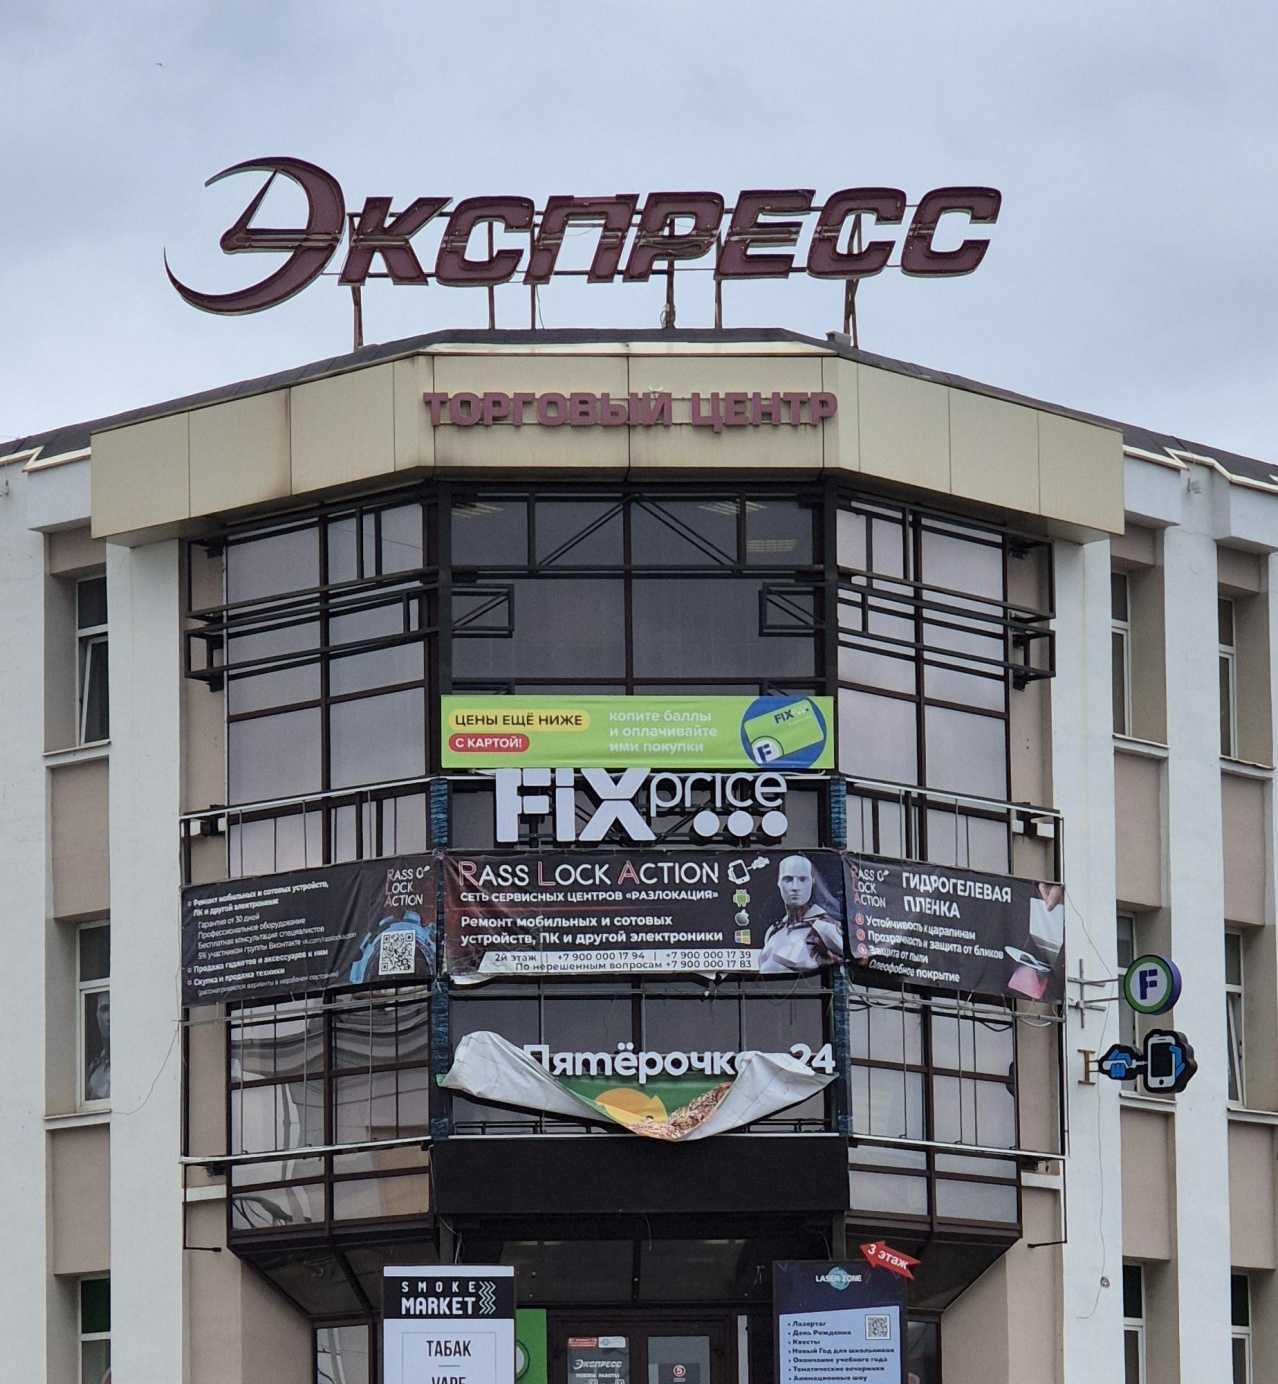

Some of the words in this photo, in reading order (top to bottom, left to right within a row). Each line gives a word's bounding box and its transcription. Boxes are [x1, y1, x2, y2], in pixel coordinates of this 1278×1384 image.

[164, 156, 1002, 317] ЭКСПРЕСС
[423, 386, 672, 426] ТОРГОВЫЙ
[691, 392, 838, 433] ЦЕНТР
[455, 715, 498, 726] ЦЕНЫ
[503, 712, 534, 727] ЕЩЁ
[539, 715, 583, 726] НИЖЕ
[609, 711, 660, 721] копите
[663, 709, 712, 721] баллы
[774, 709, 795, 724] FIX
[609, 727, 619, 737] и
[622, 724, 718, 737] оплачивайте
[455, 738, 465, 748] С
[467, 735, 523, 748] КАРТОЙ!
[608, 743, 640, 753] ими
[643, 743, 704, 755] покупки
[386, 868, 414, 881] RASS
[459, 861, 530, 887] RASS
[538, 860, 612, 887] LOCK
[617, 860, 720, 885] ACTION
[385, 880, 414, 895] LOCK
[852, 879, 877, 894] LOCK
[902, 871, 1012, 903] ГИДРОГЕЛЕВАЯ
[384, 894, 424, 908] ACTION
[460, 892, 489, 902] СЕТЬ
[491, 891, 565, 902] СЕРВИСНЫХ
[567, 891, 623, 903] ЦЕНТРОВ
[625, 890, 719, 902] «РАЗЛОКАЦИЯ»
[855, 891, 887, 908] ACTION
[903, 895, 961, 919] ПЛЕНКА
[461, 916, 513, 928] Ремонт
[516, 914, 598, 928] мобильных
[601, 917, 611, 927] и
[614, 916, 673, 927] сотовых
[866, 915, 922, 932] Устойчивость
[928, 925, 976, 940] царапинам
[461, 932, 537, 947] устройств,
[540, 932, 561, 944] ПК
[563, 934, 573, 943] и
[576, 931, 627, 946] другой
[630, 931, 723, 944] электроники
[868, 930, 922, 948] Прозрачность
[929, 940, 962, 953] защита
[963, 944, 973, 955] от
[973, 944, 1004, 960] бликов
[511, 953, 537, 962] этаж
[571, 952, 592, 961] 900
[595, 952, 616, 961] 000
[619, 952, 629, 960] 17
[631, 951, 645, 960] 94
[666, 951, 677, 959] +7
[681, 951, 701, 960] 900
[704, 951, 724, 960] 000
[727, 951, 737, 959] 17
[739, 950, 752, 959] 39
[868, 945, 900, 959] Защита
[900, 950, 909, 960] от
[515, 962, 530, 971] По
[609, 960, 663, 972] вопросам
[666, 960, 677, 969] +7
[681, 960, 701, 969] 900
[704, 960, 724, 969] 000
[727, 960, 737, 968] 17
[739, 960, 752, 969] 83
[915, 968, 961, 983] покрытие
[1139, 968, 1159, 1001] F
[523, 1042, 750, 1085] Пятёрочк
[790, 1043, 836, 1076] 24
[867, 1243, 877, 1255] 3
[878, 1250, 910, 1270] этаж
[401, 1281, 477, 1293] SMOKE
[401, 1297, 477, 1315] MARKET
[426, 1340, 472, 1357] ТАБАК
